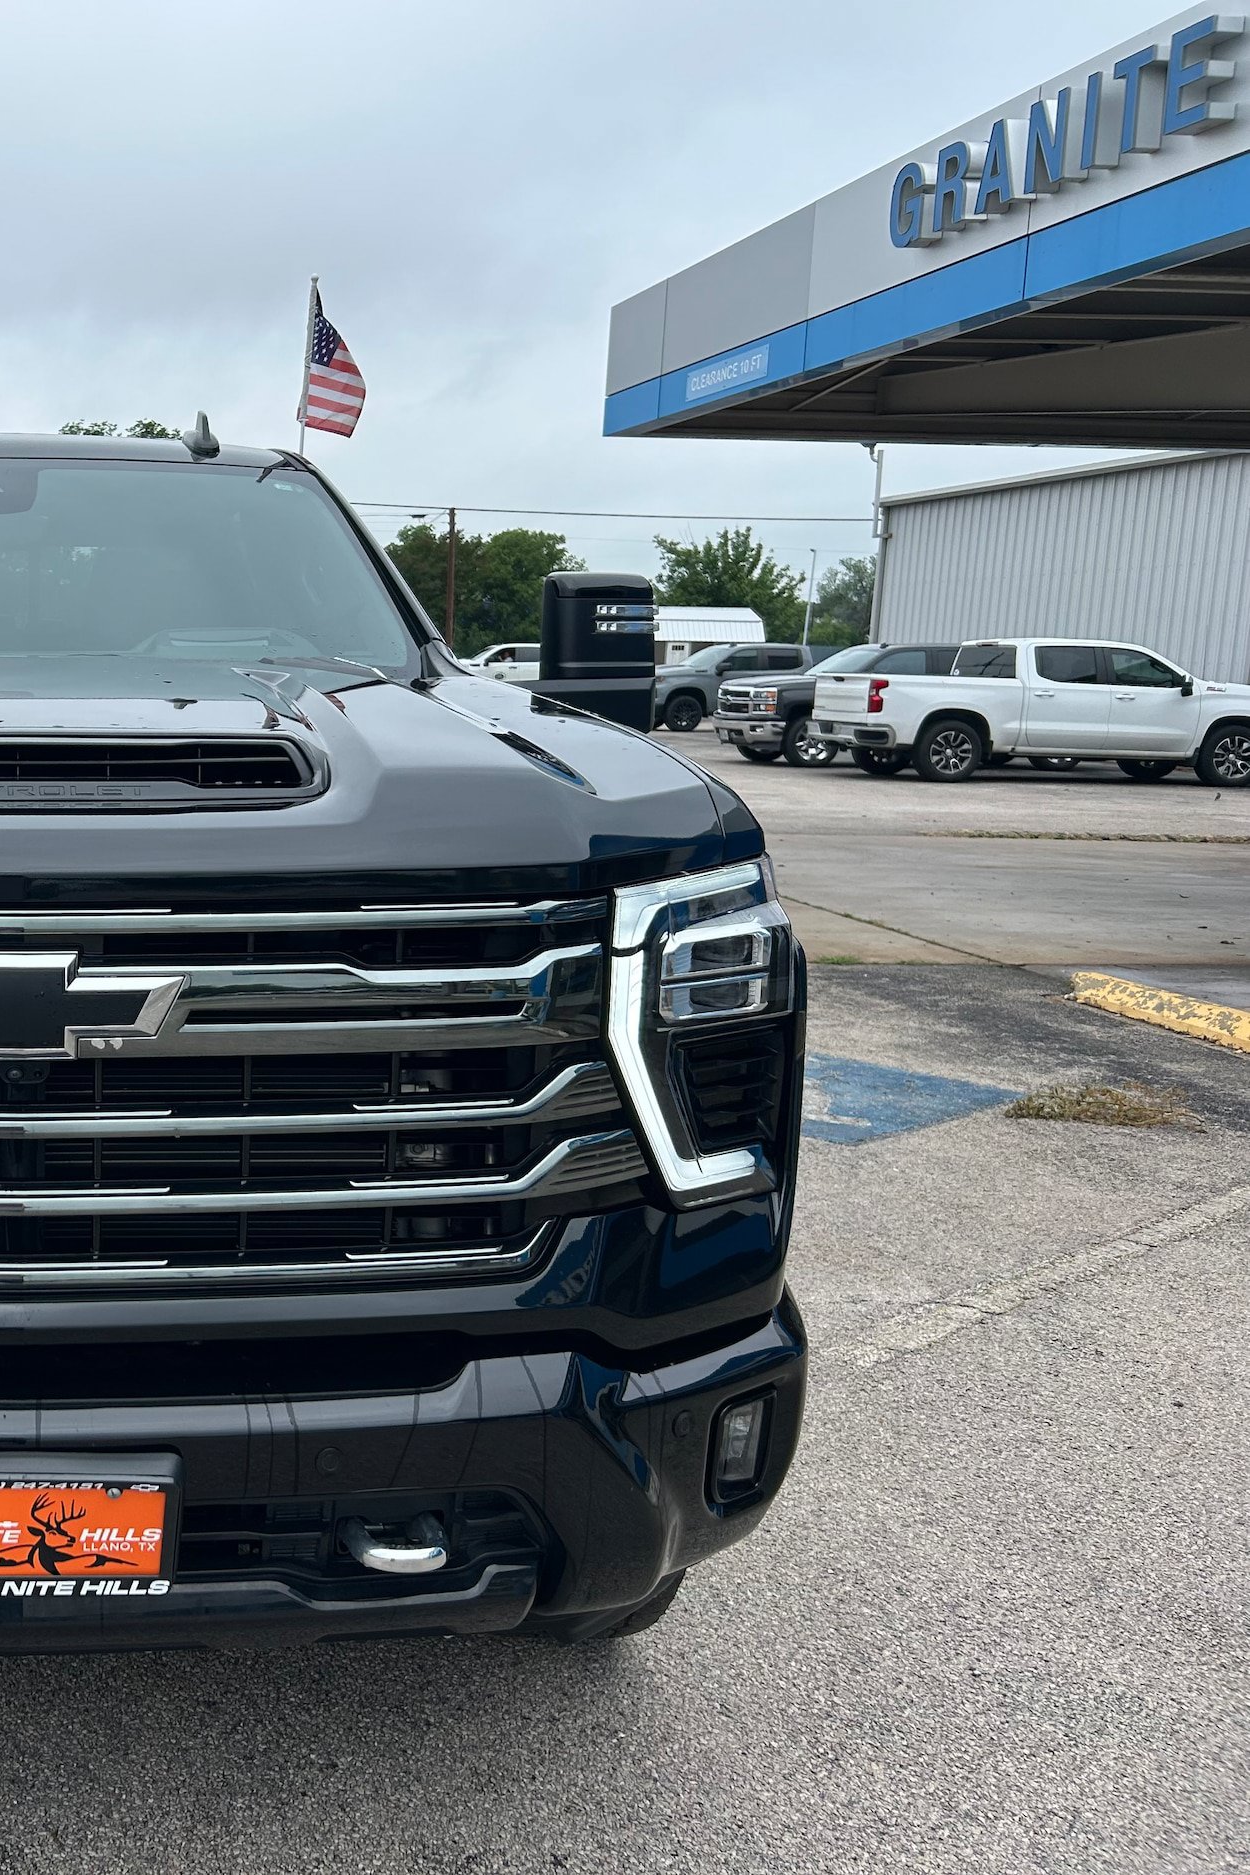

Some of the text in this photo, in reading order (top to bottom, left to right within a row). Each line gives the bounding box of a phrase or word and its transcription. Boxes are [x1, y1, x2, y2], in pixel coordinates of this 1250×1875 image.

[889, 14, 1238, 248] GRANITE
[690, 354, 763, 391] CLEARANCE 10 FT
[79, 1528, 163, 1542] HILLS
[83, 1542, 156, 1552] LLANO, TX
[79, 1579, 170, 1596] HILLS
